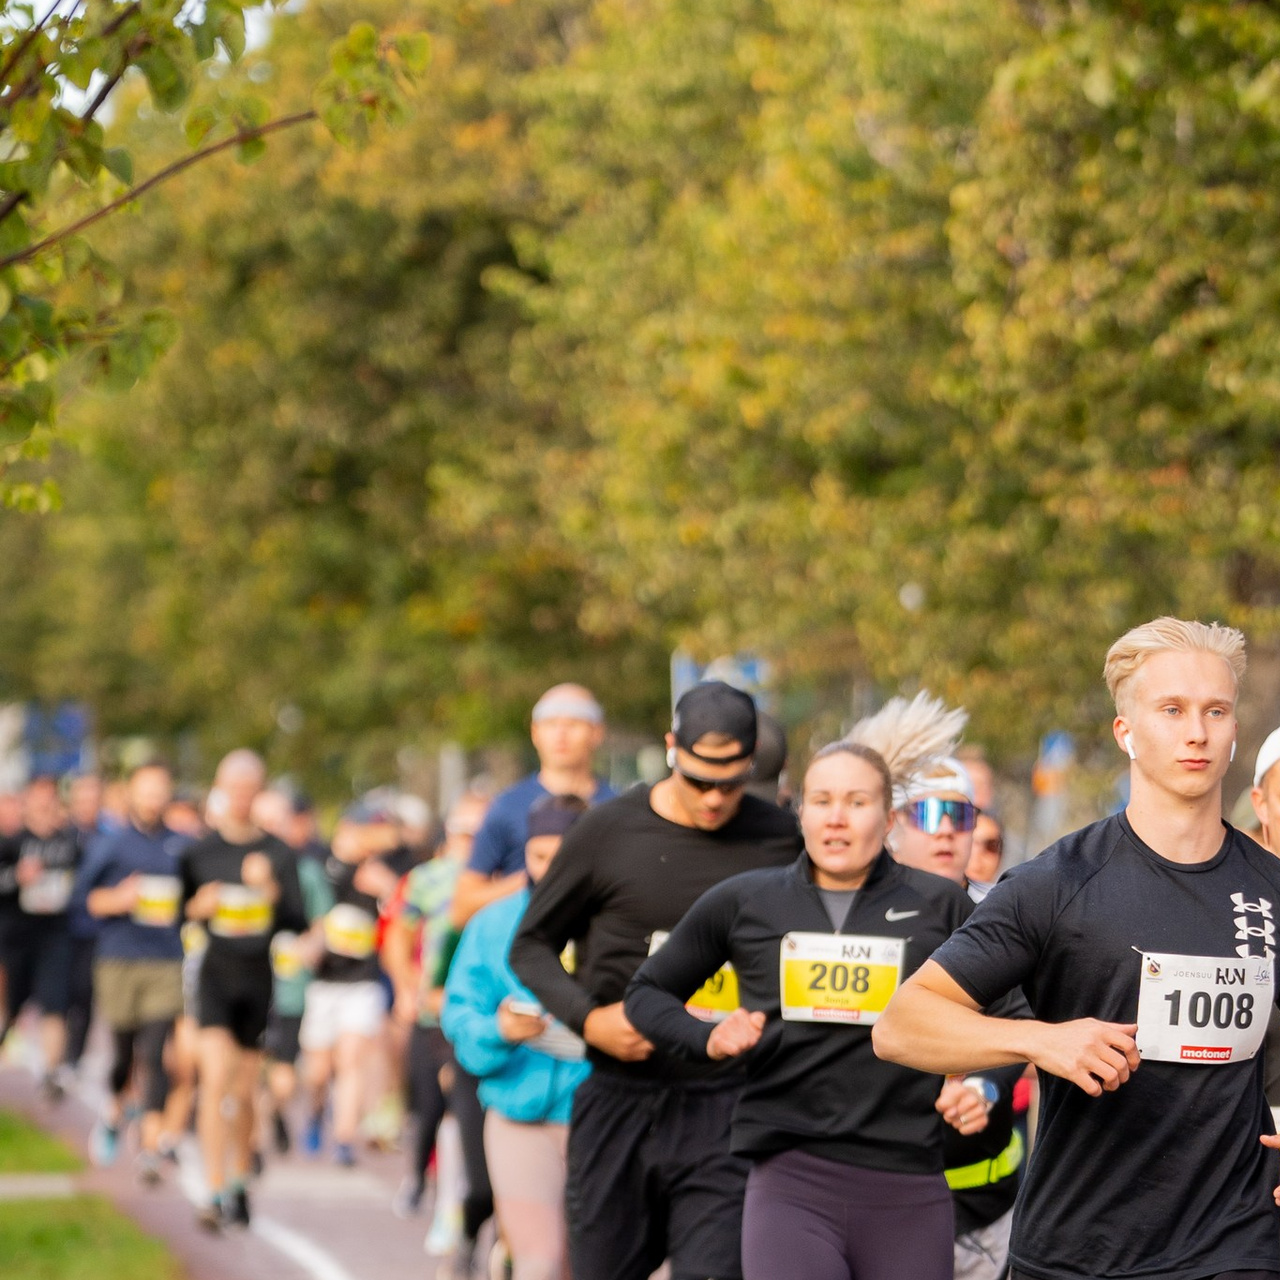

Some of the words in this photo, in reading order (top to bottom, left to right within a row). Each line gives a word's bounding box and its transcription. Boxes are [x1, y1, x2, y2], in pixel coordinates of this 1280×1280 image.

[809, 963, 870, 993] 208
[1173, 971, 1212, 979] JOENSUU
[1215, 967, 1246, 985] RUN
[1164, 989, 1254, 1030] 1008
[1182, 1049, 1231, 1059] motonet
